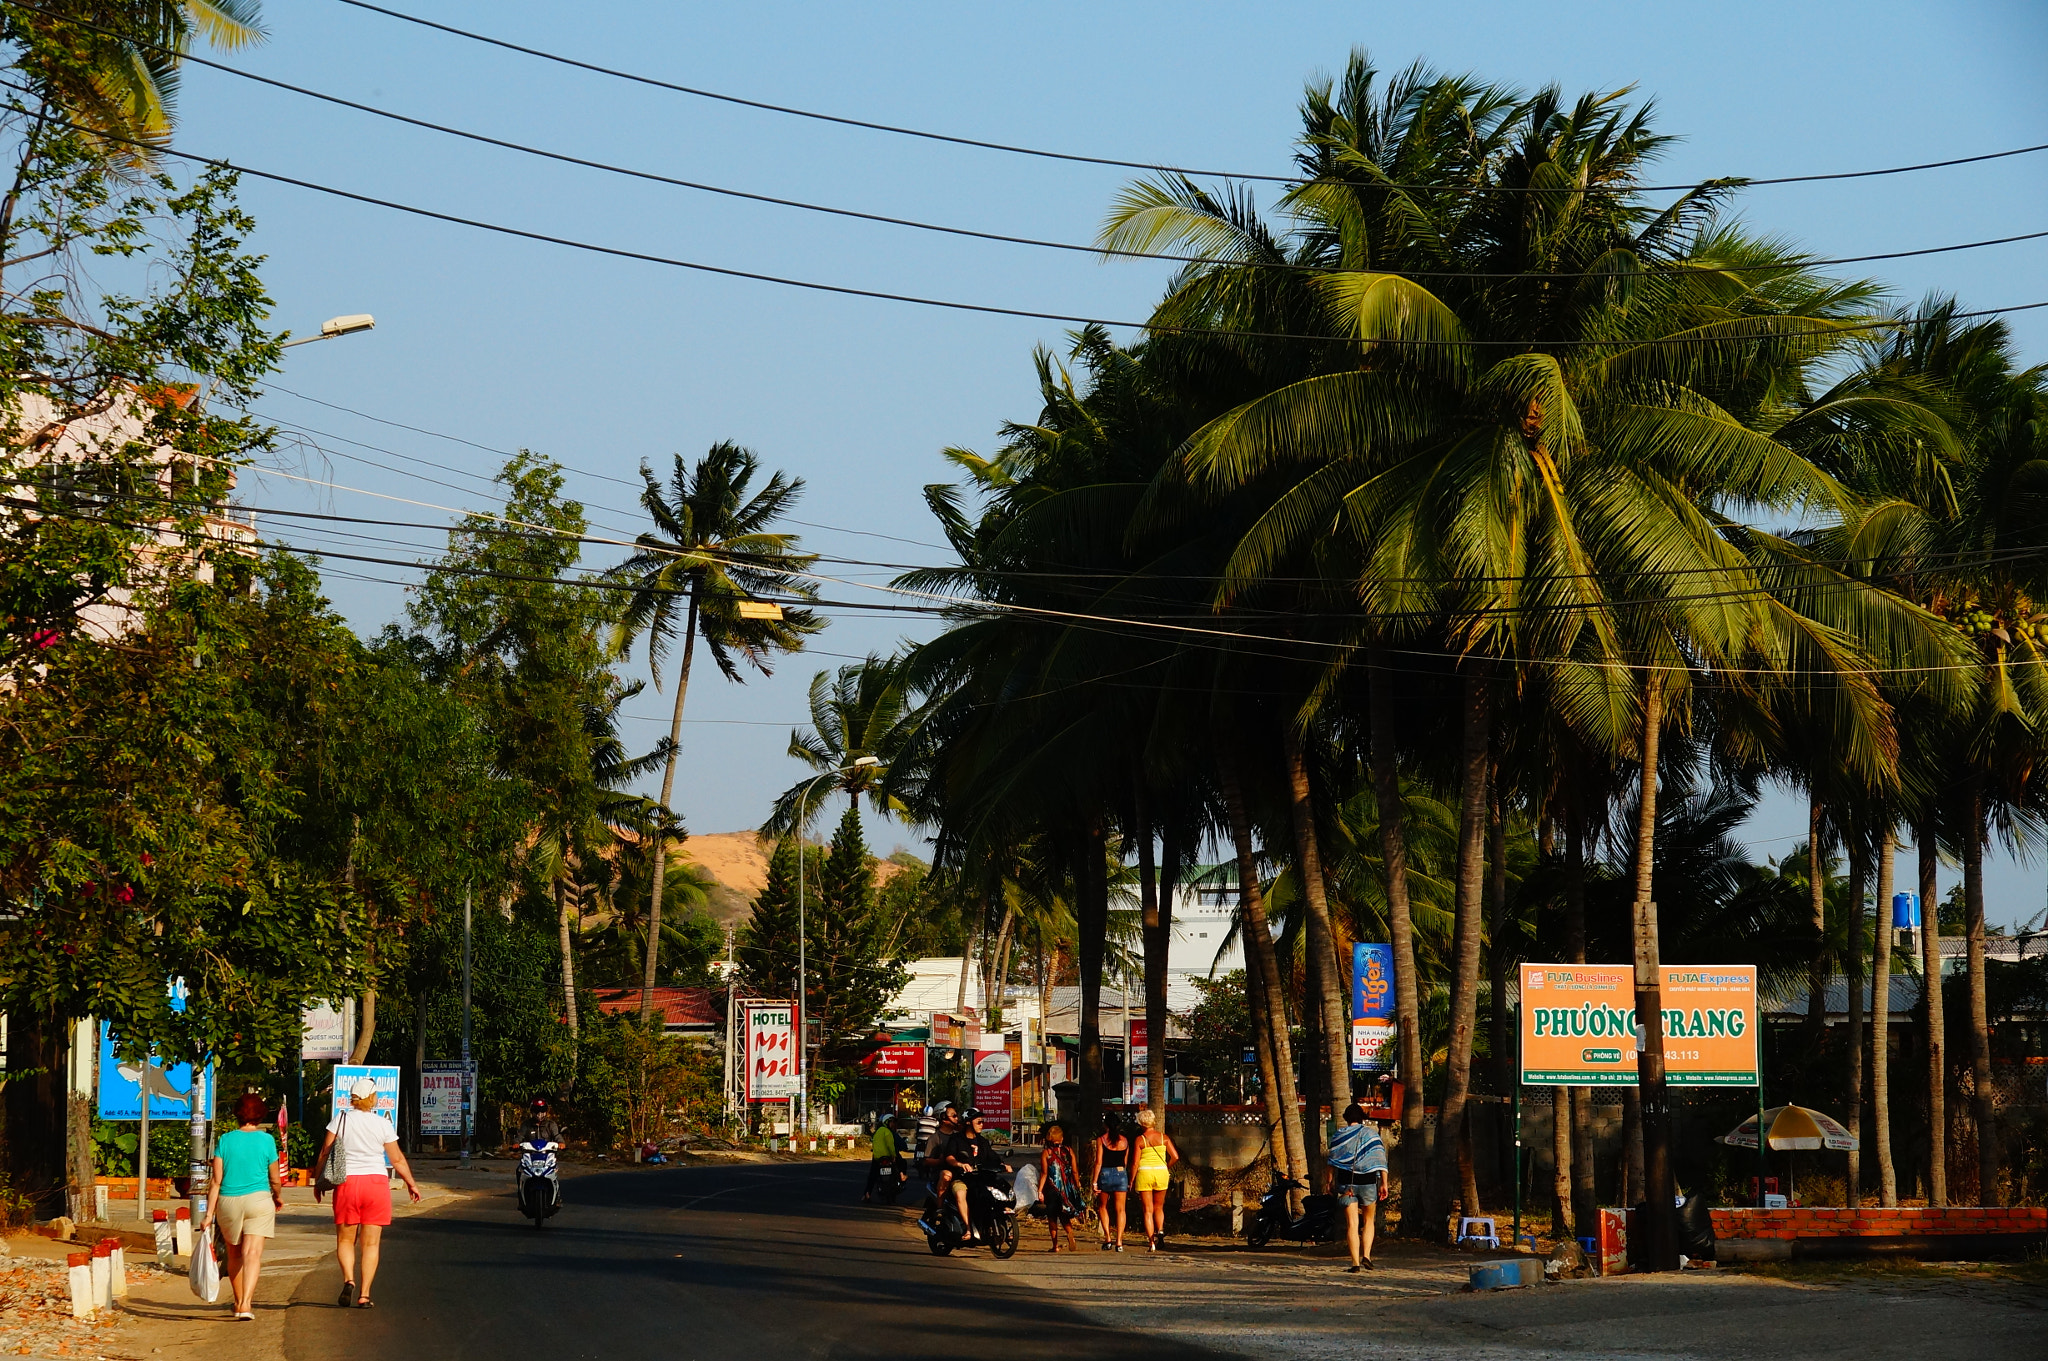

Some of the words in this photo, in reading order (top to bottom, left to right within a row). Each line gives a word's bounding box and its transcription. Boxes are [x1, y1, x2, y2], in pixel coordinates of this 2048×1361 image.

[1547, 972, 1573, 983] FUTA
[1574, 972, 1623, 983] Buslines
[1362, 958, 1389, 1013] Tiger
[753, 1013, 791, 1026] HOTEL
[1626, 1050, 1638, 1062] (0
[377, 1072, 396, 1092] QUÁN
